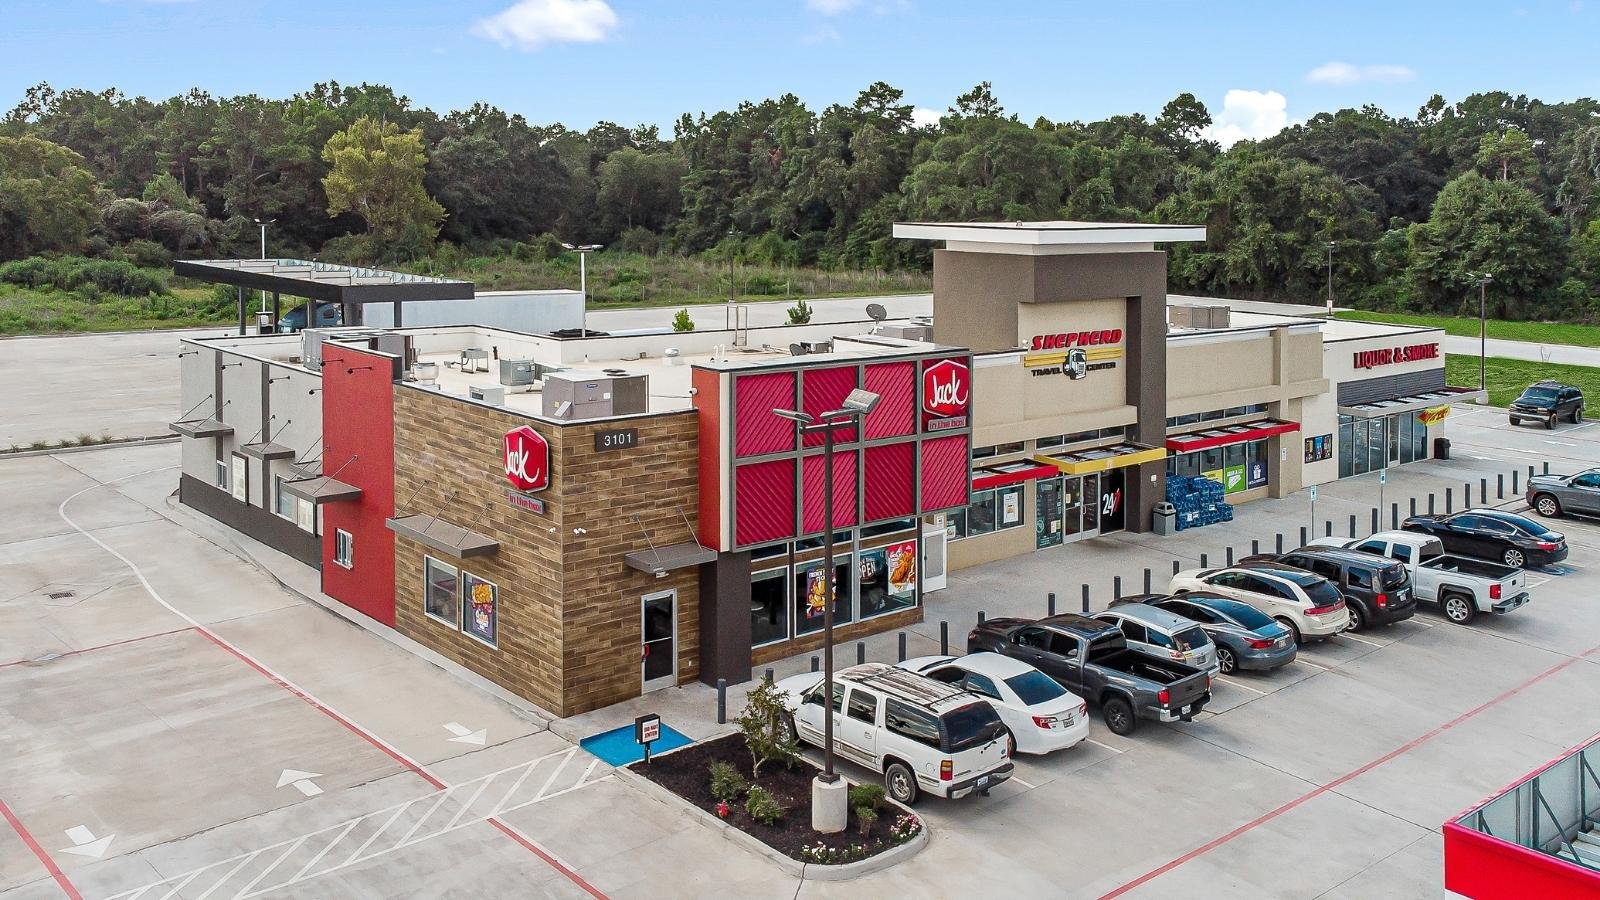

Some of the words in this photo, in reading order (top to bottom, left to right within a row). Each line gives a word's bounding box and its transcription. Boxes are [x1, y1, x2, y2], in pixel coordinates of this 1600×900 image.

[1031, 329, 1122, 350] SHEPHERD
[1353, 349, 1392, 369] LIQUOR
[1393, 347, 1403, 363] &
[1404, 343, 1439, 362] SMOKE
[1031, 367, 1062, 377] TRAVEL
[1086, 362, 1116, 371] CENTER
[930, 370, 968, 408] Jack
[604, 433, 631, 447] 3101
[504, 437, 540, 483] Jack
